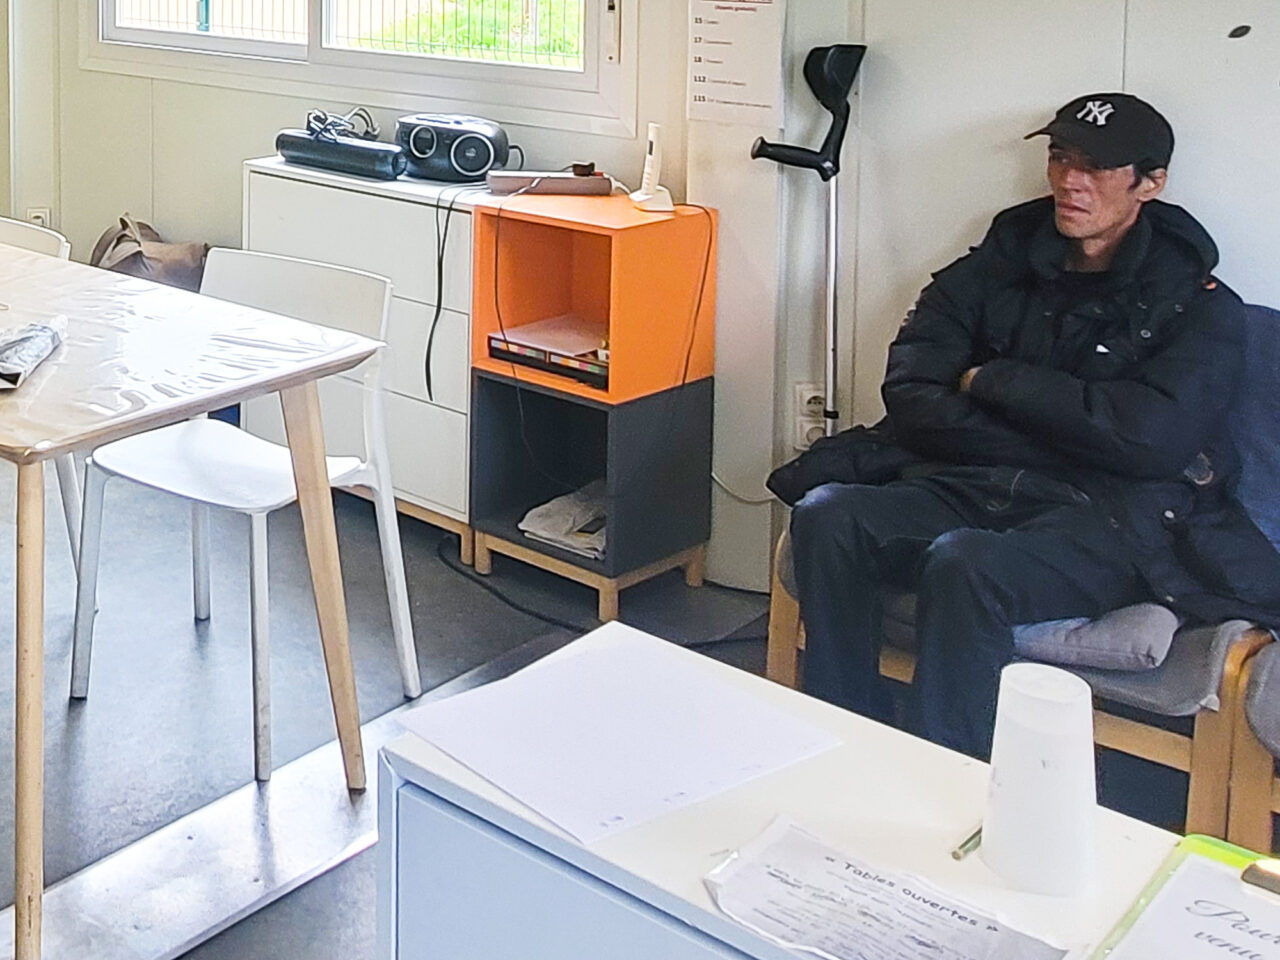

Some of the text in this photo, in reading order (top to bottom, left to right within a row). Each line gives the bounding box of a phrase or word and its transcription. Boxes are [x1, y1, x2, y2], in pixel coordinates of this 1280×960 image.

[1075, 100, 1116, 126] NY
[844, 861, 897, 888] Tables
[901, 887, 979, 927] ouvertes
